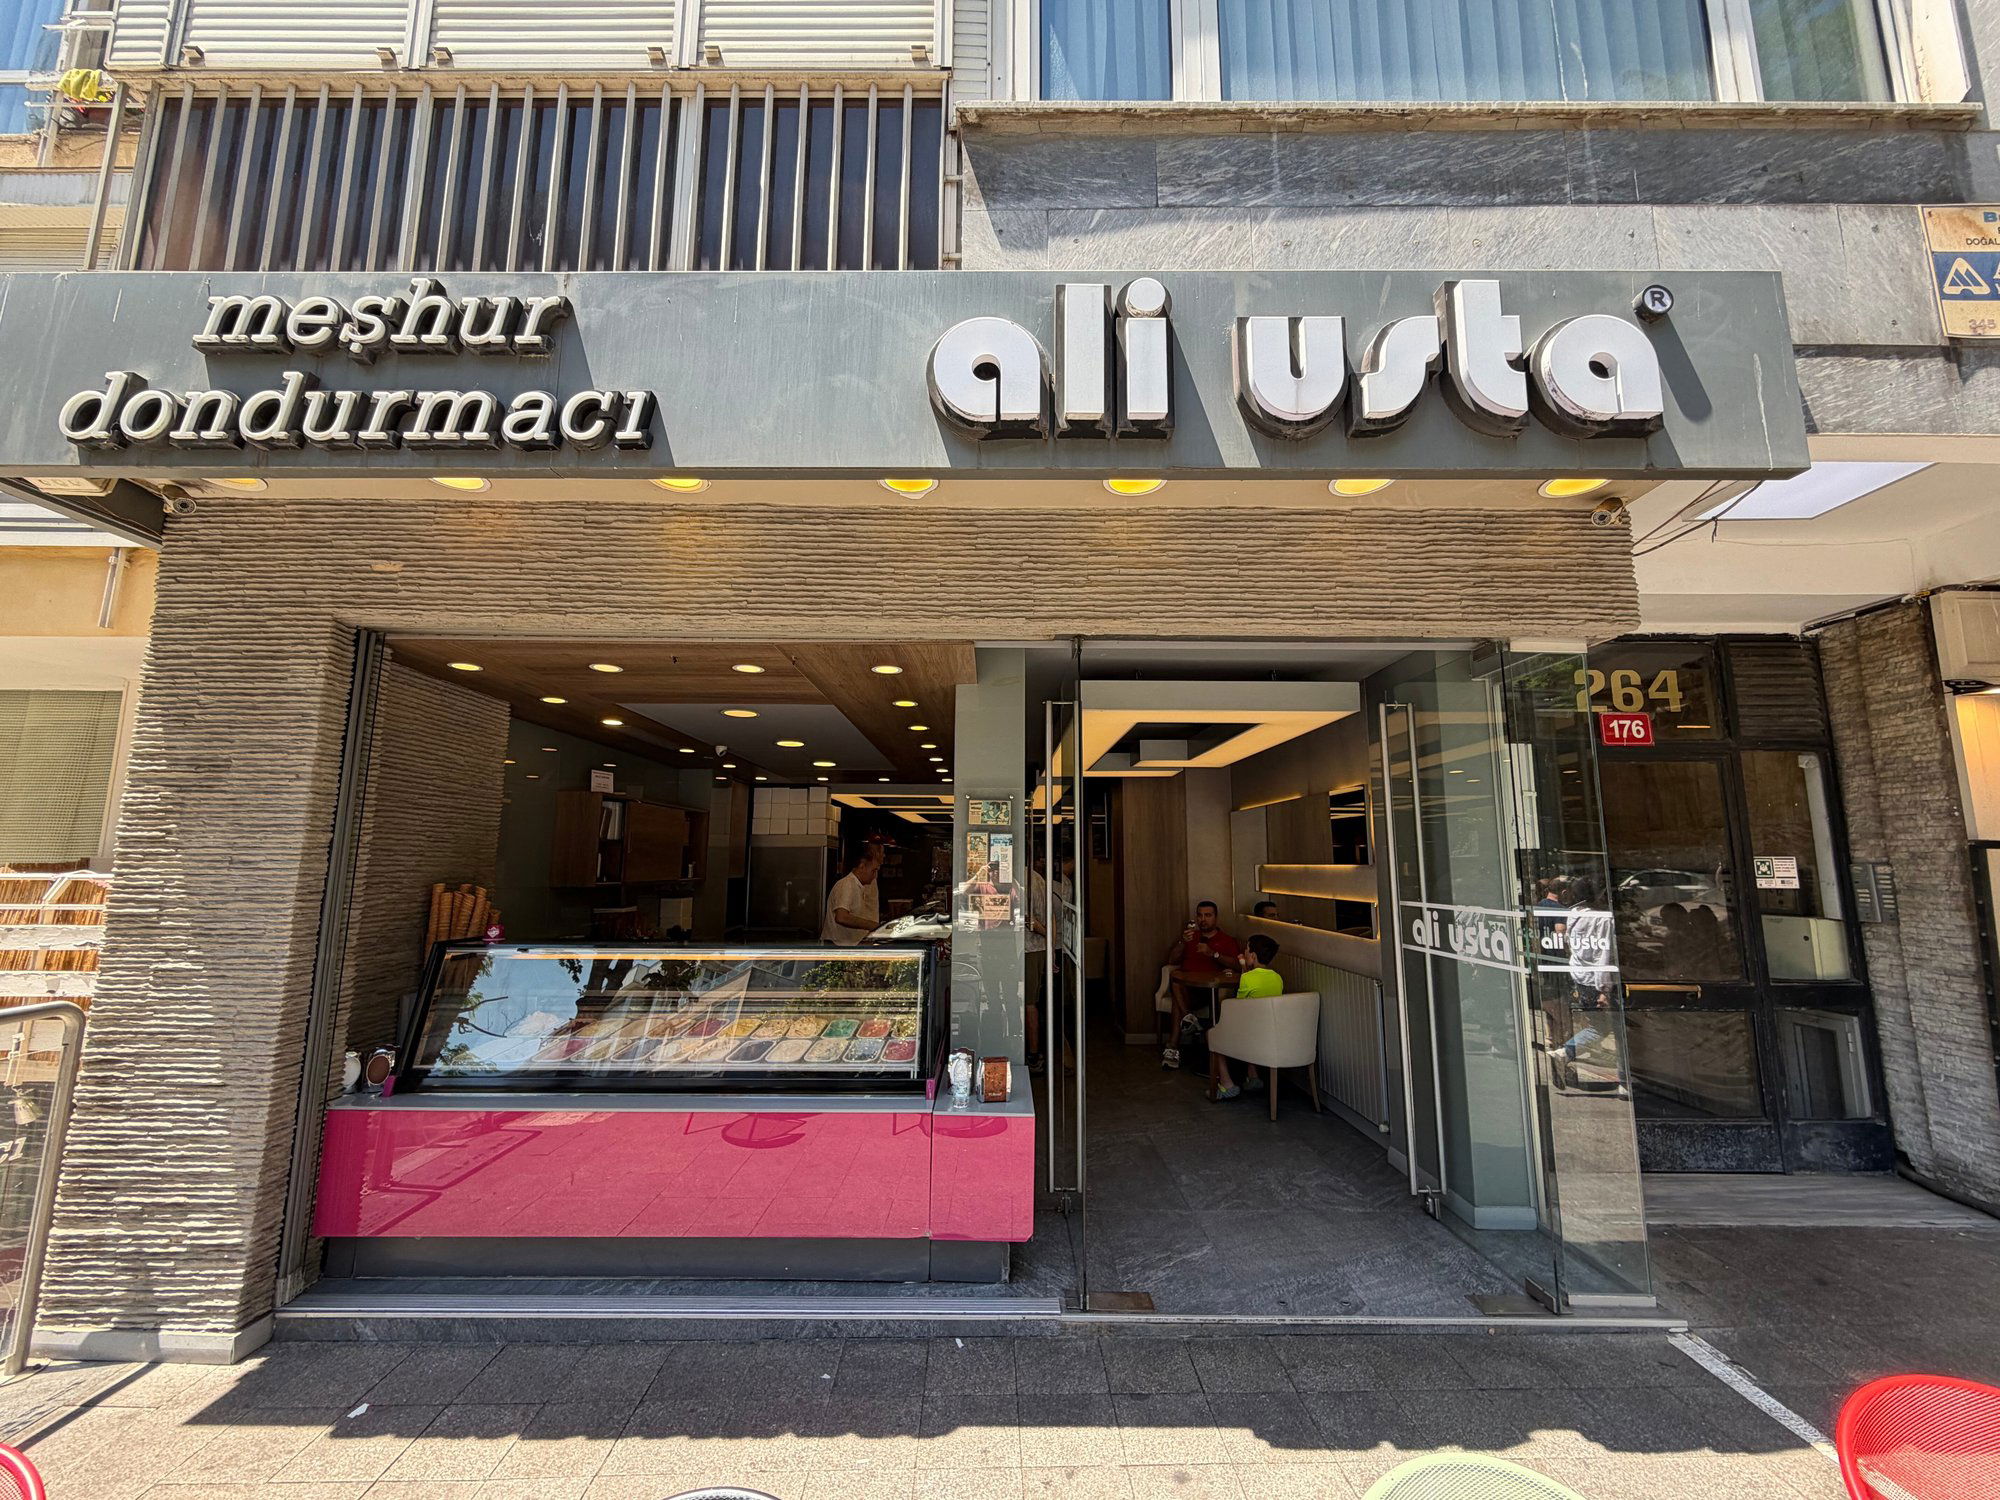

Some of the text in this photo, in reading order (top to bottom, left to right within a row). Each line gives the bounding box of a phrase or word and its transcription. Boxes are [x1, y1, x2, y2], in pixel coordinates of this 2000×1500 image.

[192, 277, 563, 354] meşhur
[931, 276, 1168, 424] ali
[1243, 278, 1663, 424] usta
[58, 370, 645, 442] dondurmacı
[1573, 669, 1684, 713] 264
[1609, 719, 1646, 739] 176
[1411, 909, 1512, 962] ali usta
[1541, 932, 1565, 950] ali
[1569, 934, 1611, 951] usta
